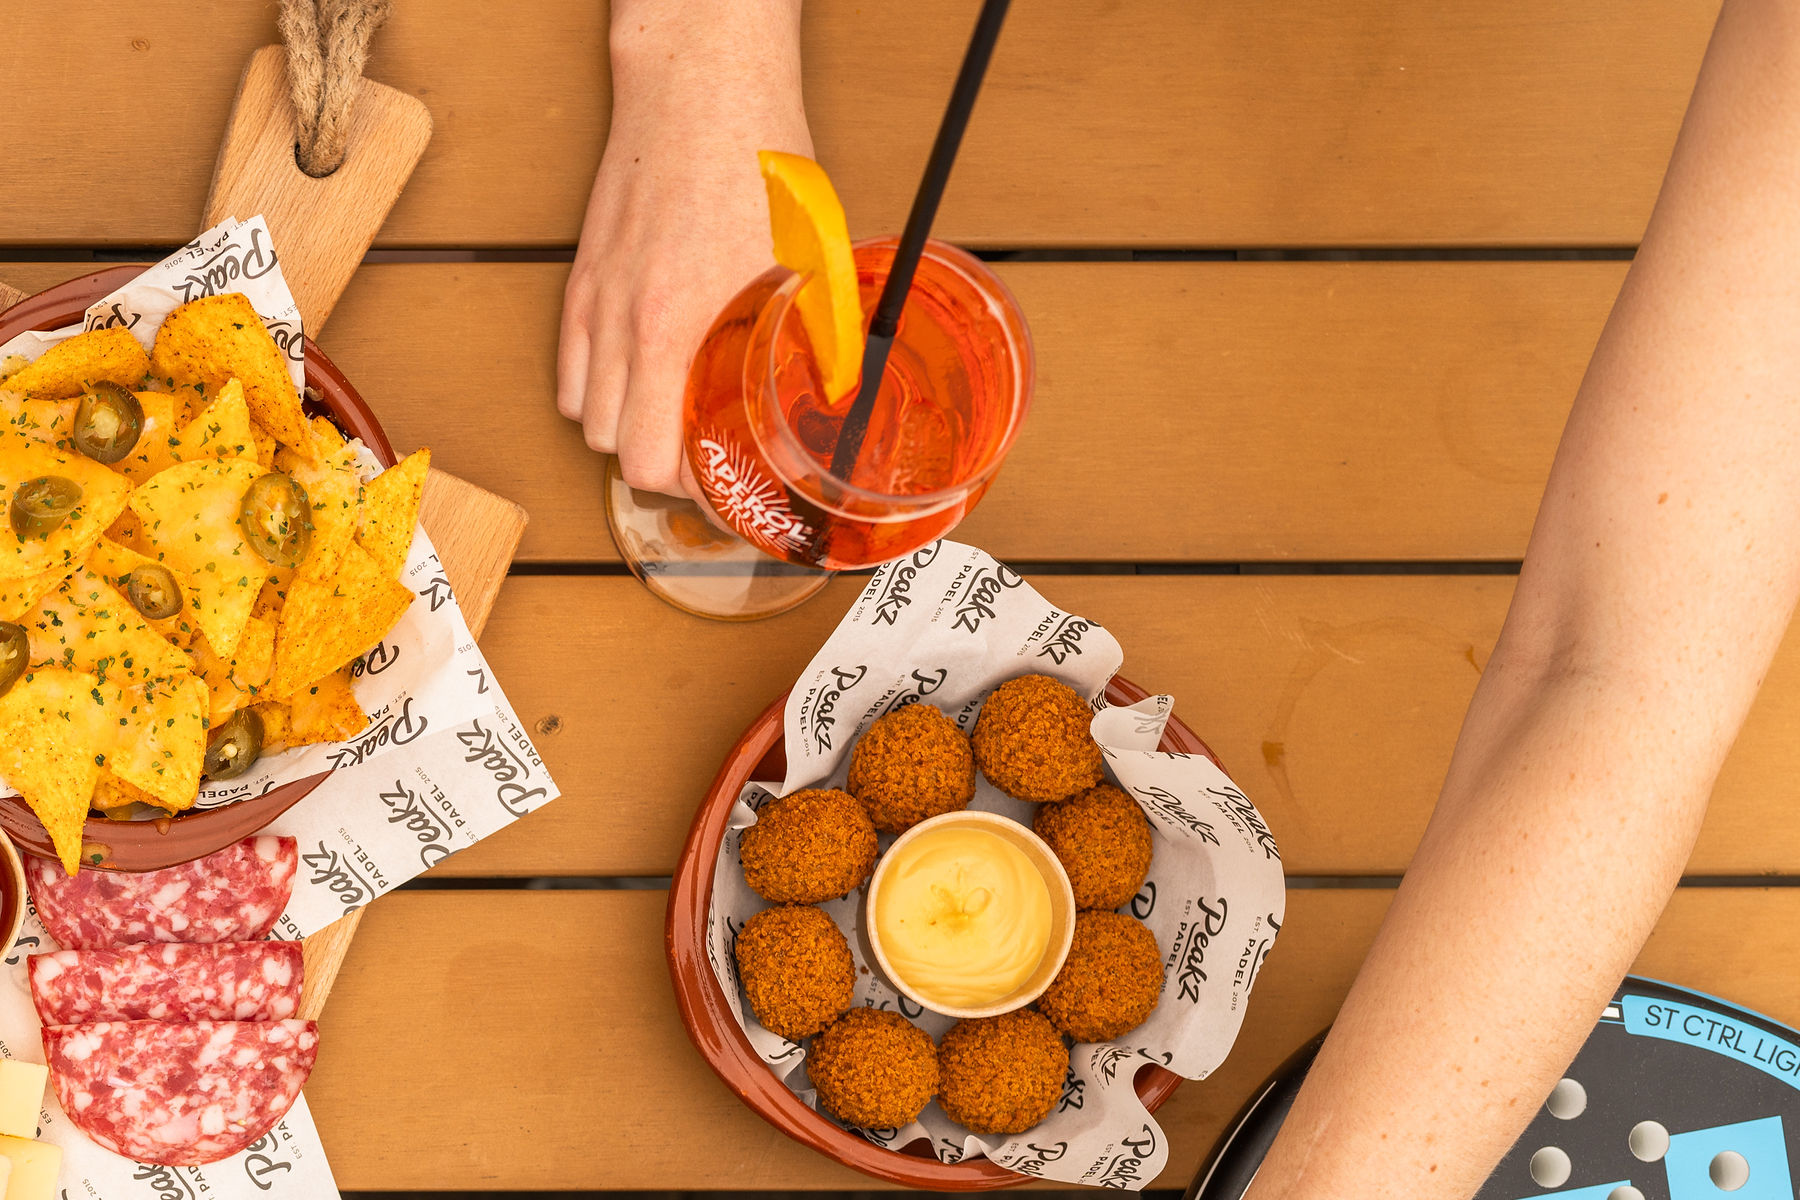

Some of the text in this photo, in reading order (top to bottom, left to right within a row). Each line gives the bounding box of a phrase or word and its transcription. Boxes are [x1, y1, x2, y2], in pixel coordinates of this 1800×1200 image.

[700, 439, 806, 541] APEROL
[939, 564, 973, 606] PADEL
[1027, 610, 1060, 643] PADEL
[800, 688, 813, 735] PADEL
[813, 665, 868, 754] Peakz
[866, 689, 895, 727] PADEL
[507, 723, 543, 765] PADEL
[200, 784, 249, 798] PADEL
[456, 719, 546, 818] Peakz
[429, 784, 465, 828] PADEL
[1134, 786, 1220, 847] Peakz
[1206, 786, 1281, 859] Peakz
[1212, 802, 1244, 834] PADEL
[355, 844, 388, 888] PADEL
[1165, 921, 1189, 971] PADEL
[1177, 896, 1229, 1005] Peakz
[1232, 937, 1258, 988] PADEL
[1645, 1005, 1680, 1029] ST
[1683, 1015, 1746, 1054] CTRL
[1080, 1156, 1109, 1181] PADEL
